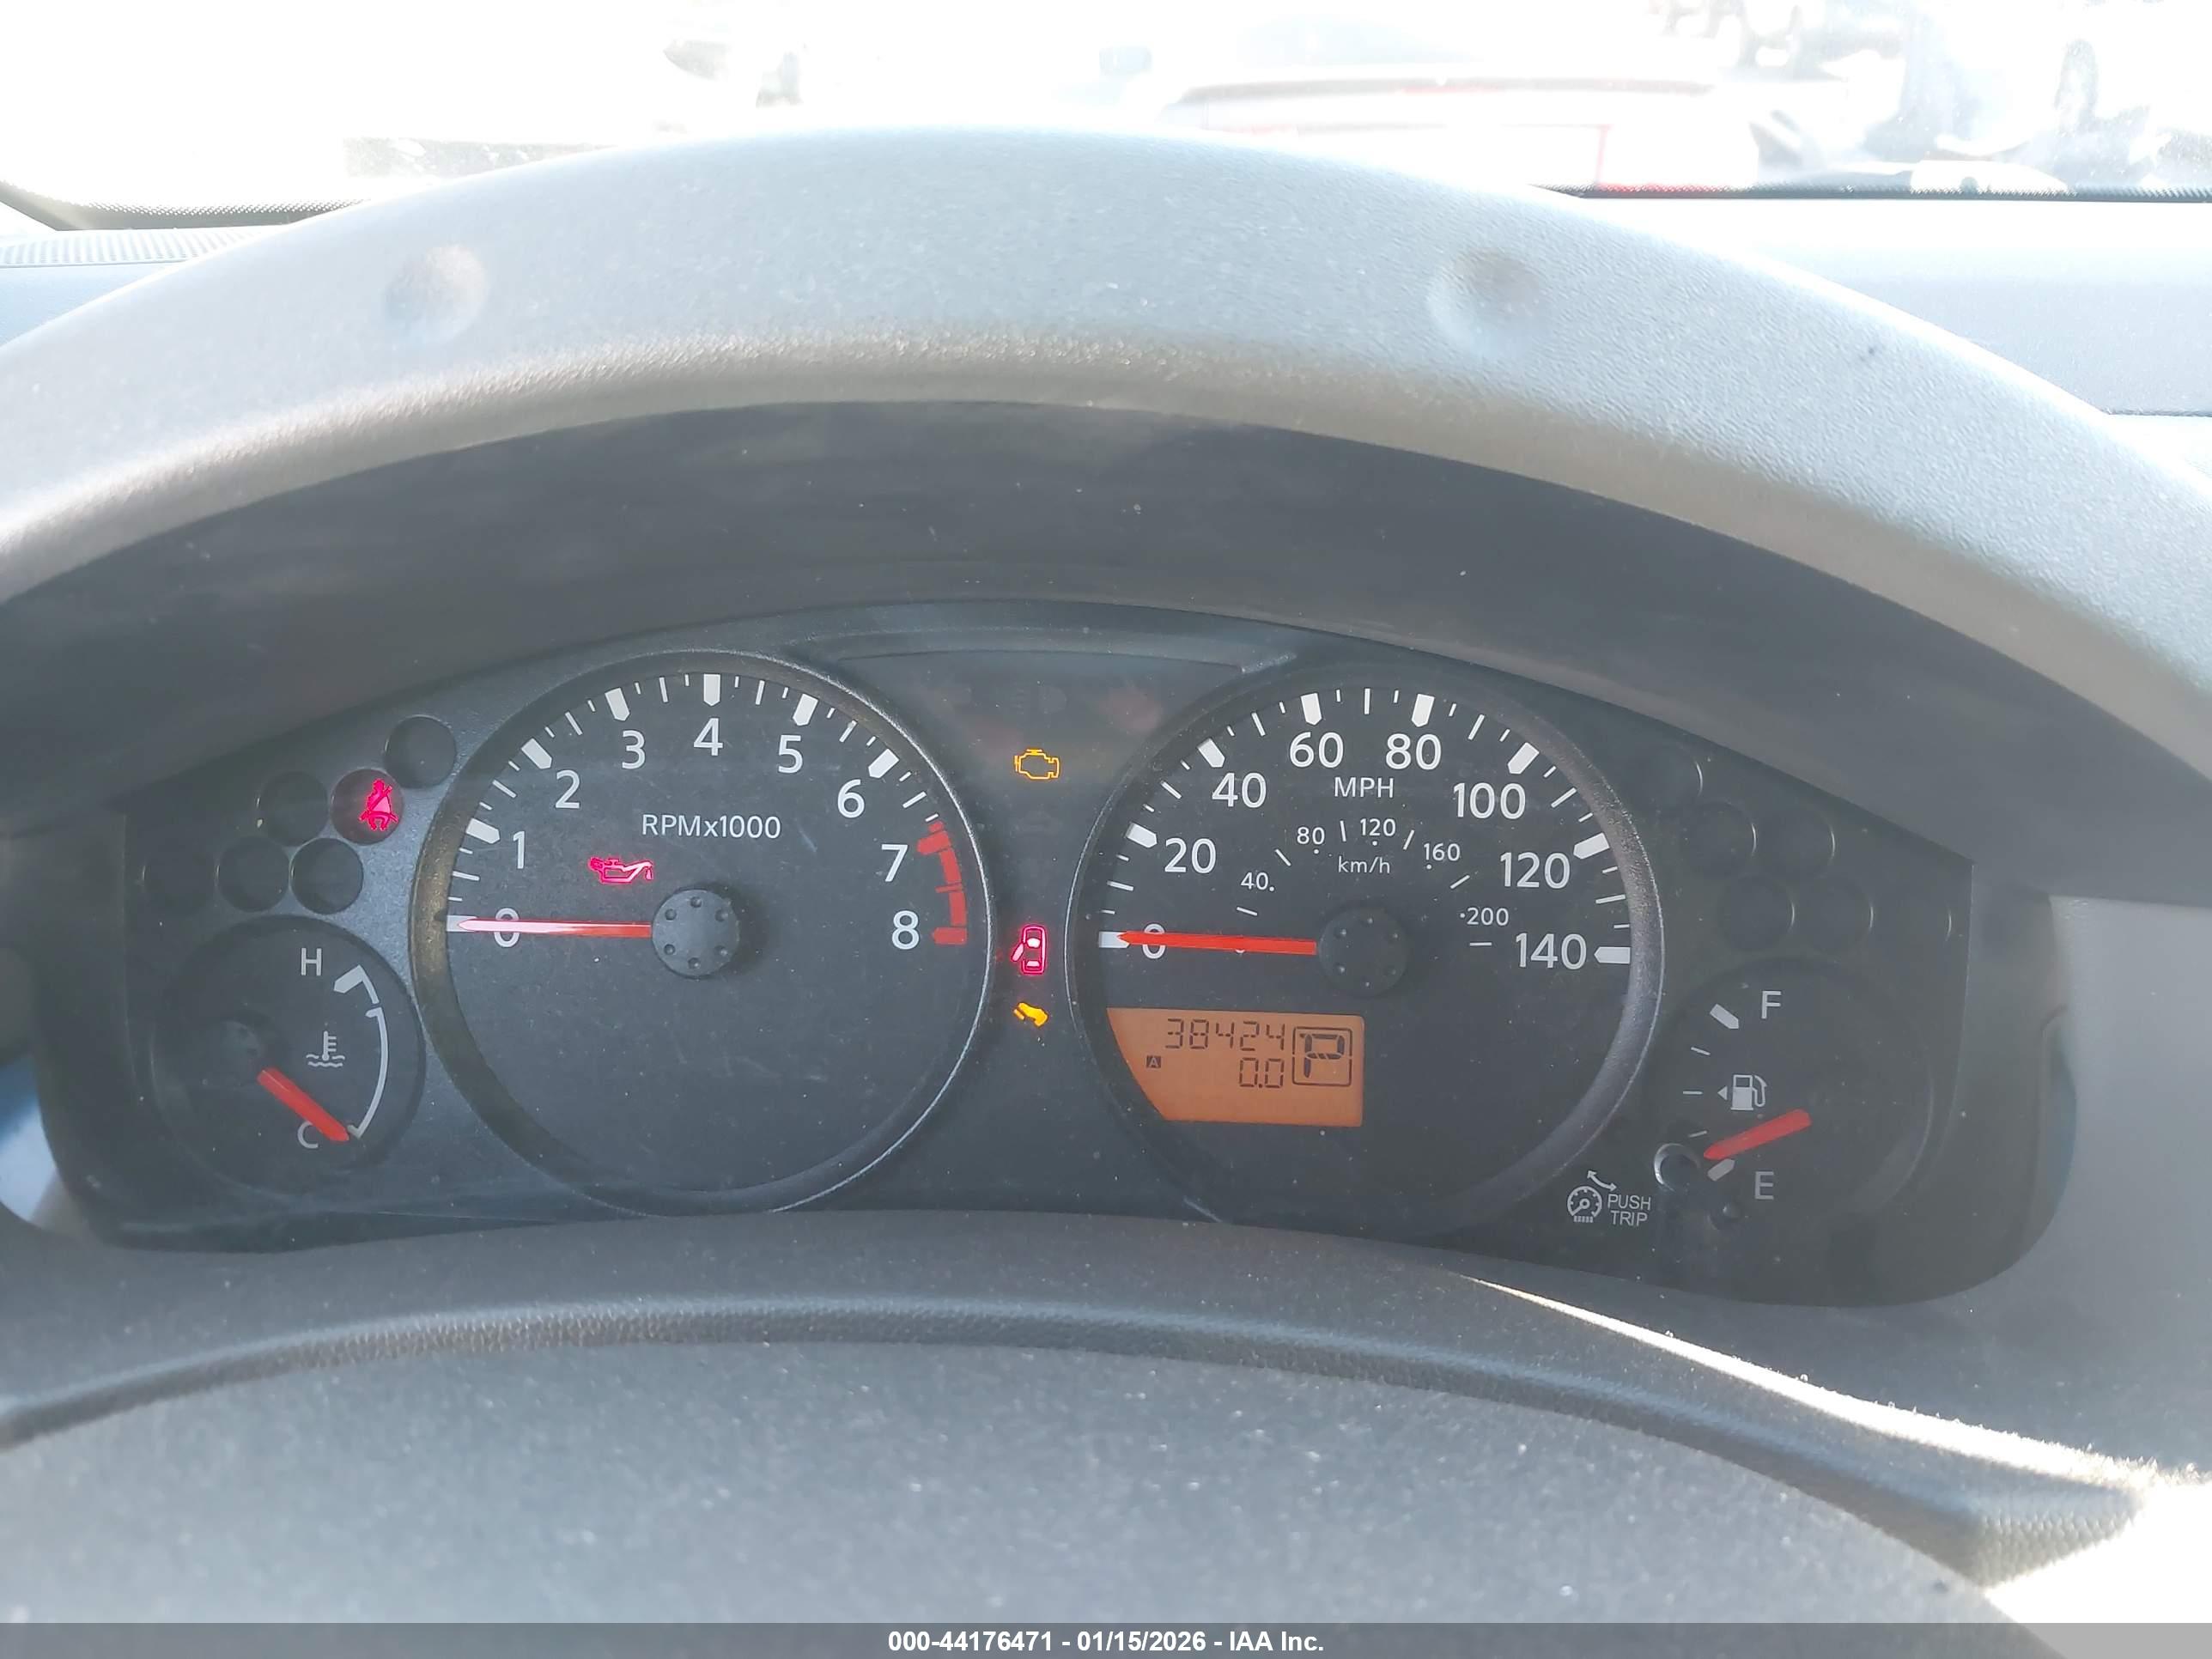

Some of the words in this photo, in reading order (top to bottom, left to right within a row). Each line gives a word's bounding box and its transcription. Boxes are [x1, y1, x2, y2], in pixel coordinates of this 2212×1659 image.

[622, 731, 646, 769] 3
[693, 718, 723, 756] 4
[778, 735, 803, 773] 5
[1290, 732, 1344, 769] 60
[1386, 733, 1442, 770] 80
[555, 769, 580, 809] 2
[837, 779, 865, 818] 6
[1212, 773, 1267, 808] 40
[1334, 776, 1395, 799] MPH
[1453, 782, 1526, 820] 100
[641, 813, 781, 839] RPMx1000
[1296, 826, 1326, 846] 80
[1361, 818, 1396, 837] 120
[513, 831, 526, 868] 1
[882, 844, 908, 882] 7
[1164, 837, 1217, 874] 20
[1338, 856, 1391, 875] km/h
[1424, 842, 1461, 862] 160
[1240, 872, 1269, 890] 40
[1499, 852, 1571, 890] 120
[494, 908, 520, 947] 0
[892, 910, 920, 950] 8
[1467, 907, 1509, 927] 200
[1143, 923, 1166, 959] 0
[1516, 933, 1588, 970] 140
[301, 947, 322, 977] H
[1762, 991, 1782, 1019] F
[1165, 1018, 1285, 1052] 38424
[1147, 1056, 1160, 1068] A
[1239, 1057, 1285, 1088] 0.0
[1299, 1033, 1346, 1079] P
[298, 1120, 319, 1149] C
[1607, 1194, 1651, 1211] PUSH
[1754, 1171, 1775, 1200] E
[1610, 1210, 1649, 1228] TRIP
